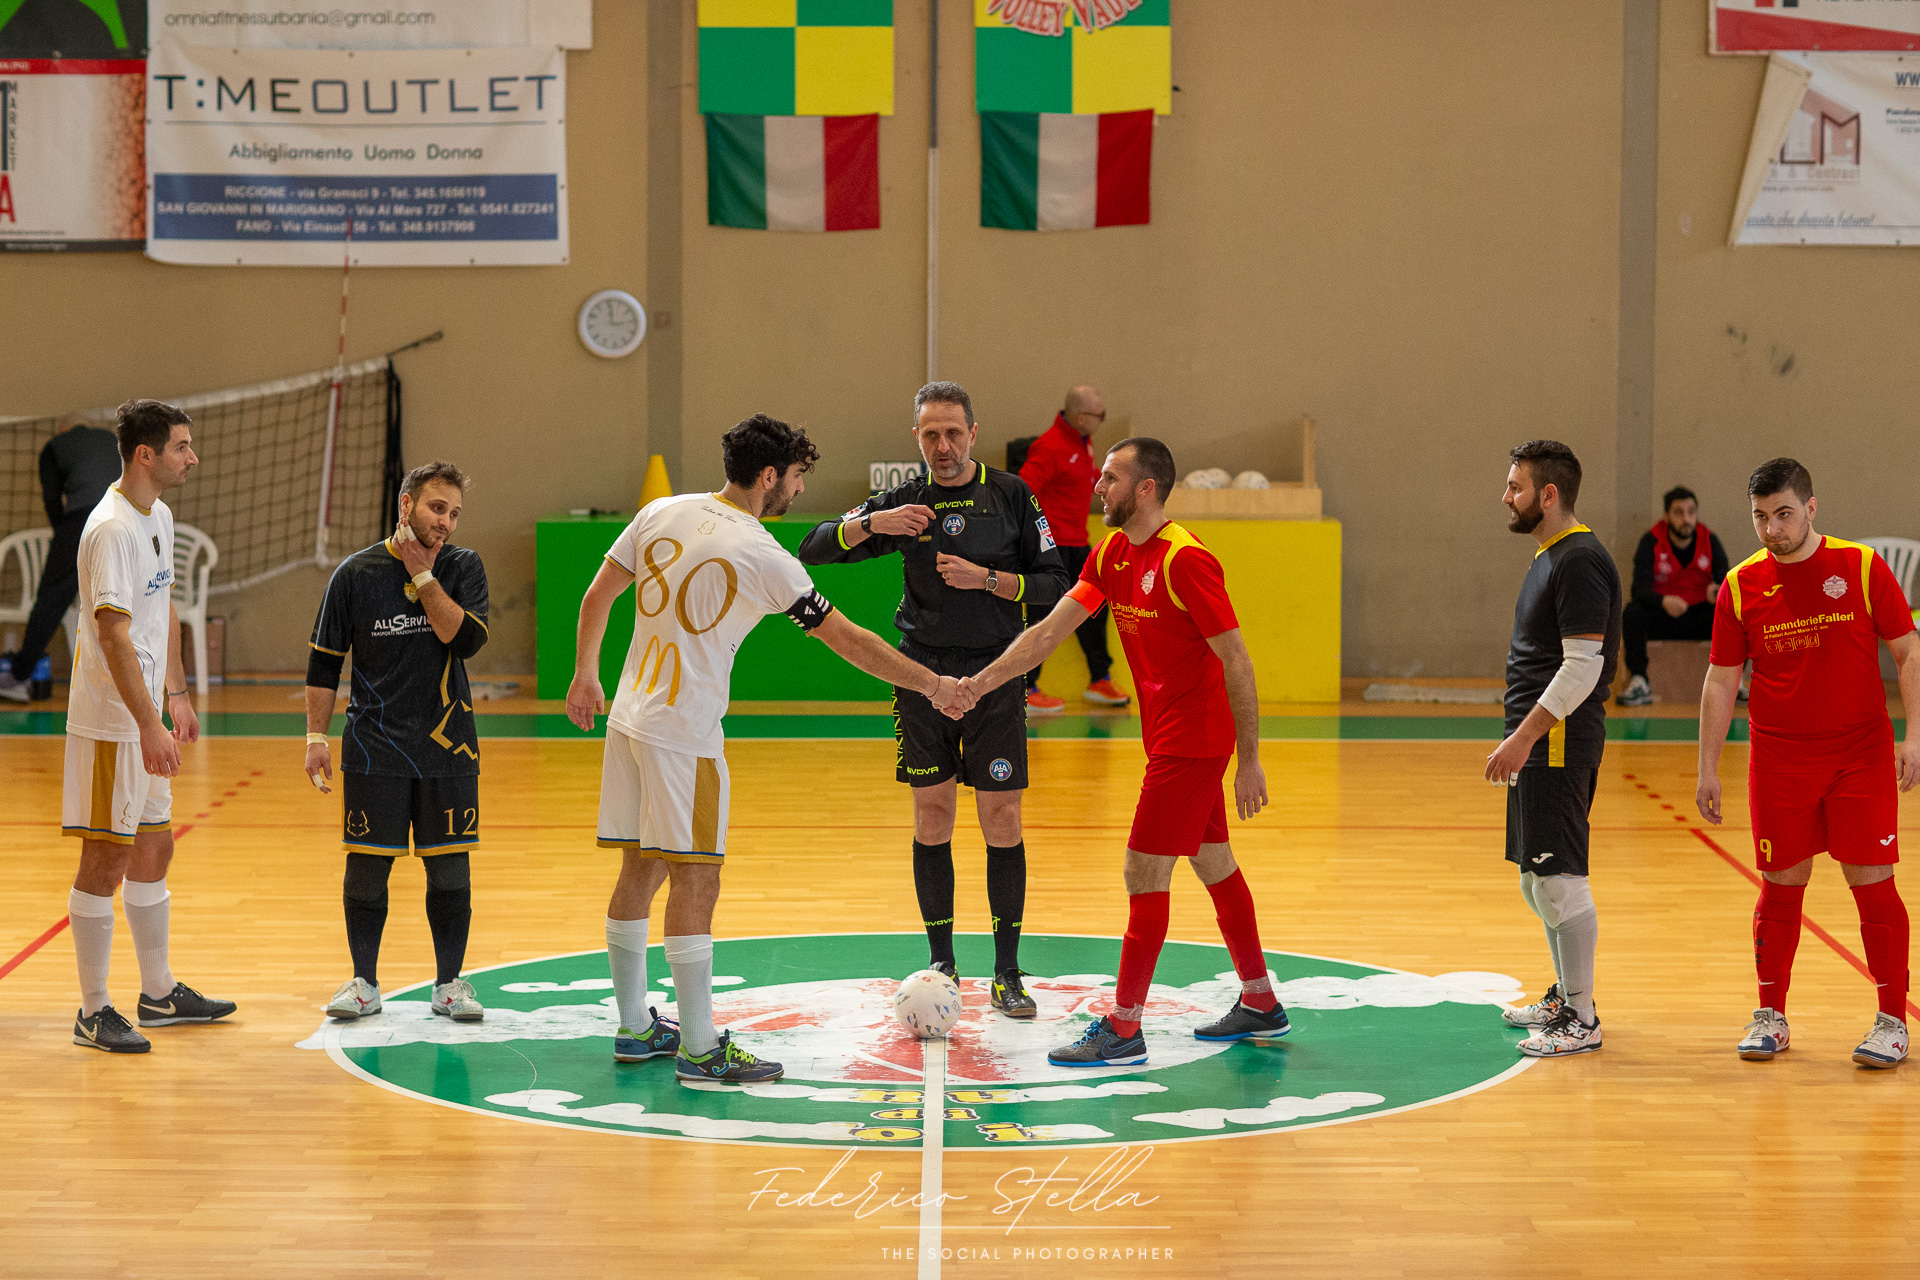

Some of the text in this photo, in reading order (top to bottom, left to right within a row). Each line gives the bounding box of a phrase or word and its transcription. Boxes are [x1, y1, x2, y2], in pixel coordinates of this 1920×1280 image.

[164, 9, 436, 27] omniafitnessurbania@gmail.com
[228, 143, 484, 163] Abbigliamento Uomo Donna
[224, 185, 287, 199] RICCIONE
[157, 202, 184, 215] SAN
[186, 202, 247, 216] GIOVANNI
[249, 203, 264, 215] IN
[265, 203, 347, 216] MARIGNANO
[355, 204, 376, 216] Via
[393, 204, 423, 216] Mare
[235, 220, 272, 233] FANO
[281, 221, 301, 233] Via
[935, 499, 974, 510] GIVOVA
[637, 537, 738, 636] 80
[1763, 611, 1855, 635] LavanderieFalleri
[444, 807, 477, 836] 12
[1759, 838, 1772, 863] 9
